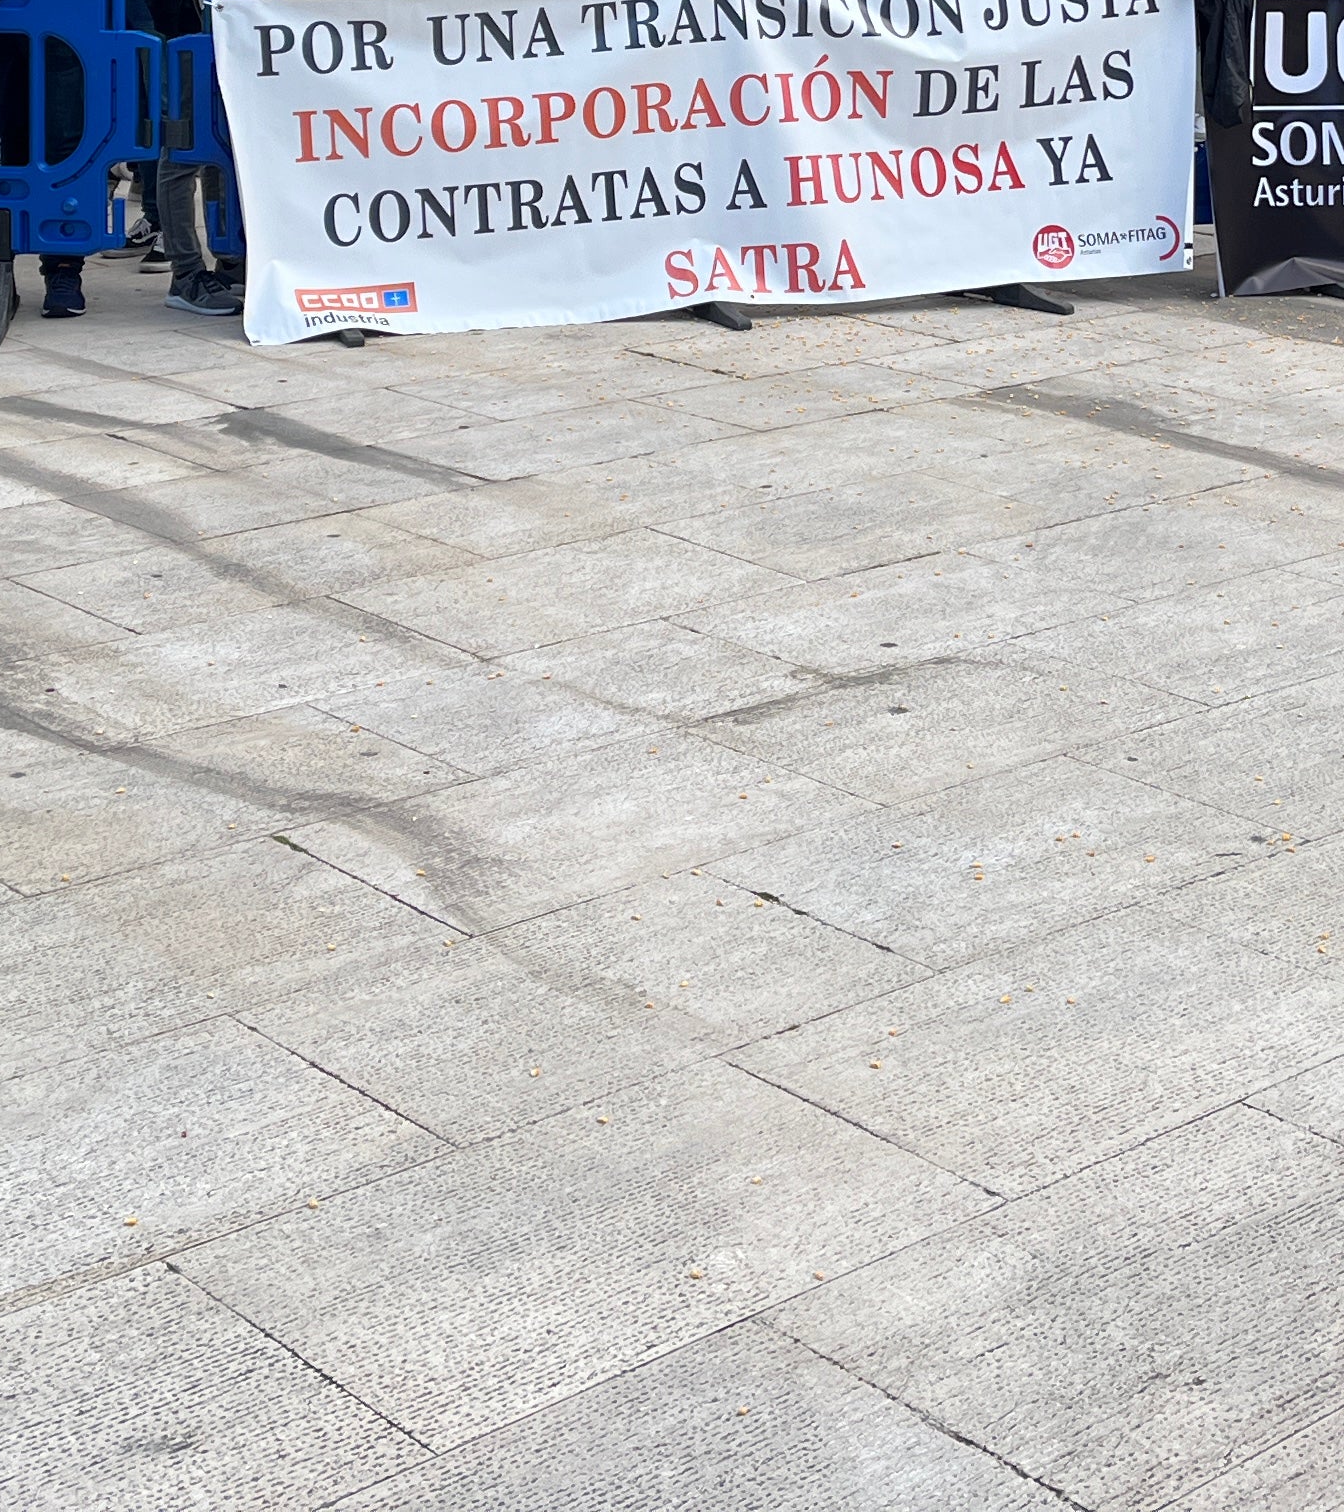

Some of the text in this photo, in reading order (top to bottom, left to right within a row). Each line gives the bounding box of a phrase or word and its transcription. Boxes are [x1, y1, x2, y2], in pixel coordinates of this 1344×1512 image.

[253, 19, 394, 78] POR
[427, 6, 564, 67] UNA
[292, 49, 1135, 164] INCORPORACIÓN DE LAS
[323, 132, 1114, 248] CONTRATAS A HUNOSA YA
[665, 238, 867, 301] SATRA
[1037, 231, 1069, 250] UGT
[301, 290, 379, 310] CCOO
[304, 310, 391, 329] industria
